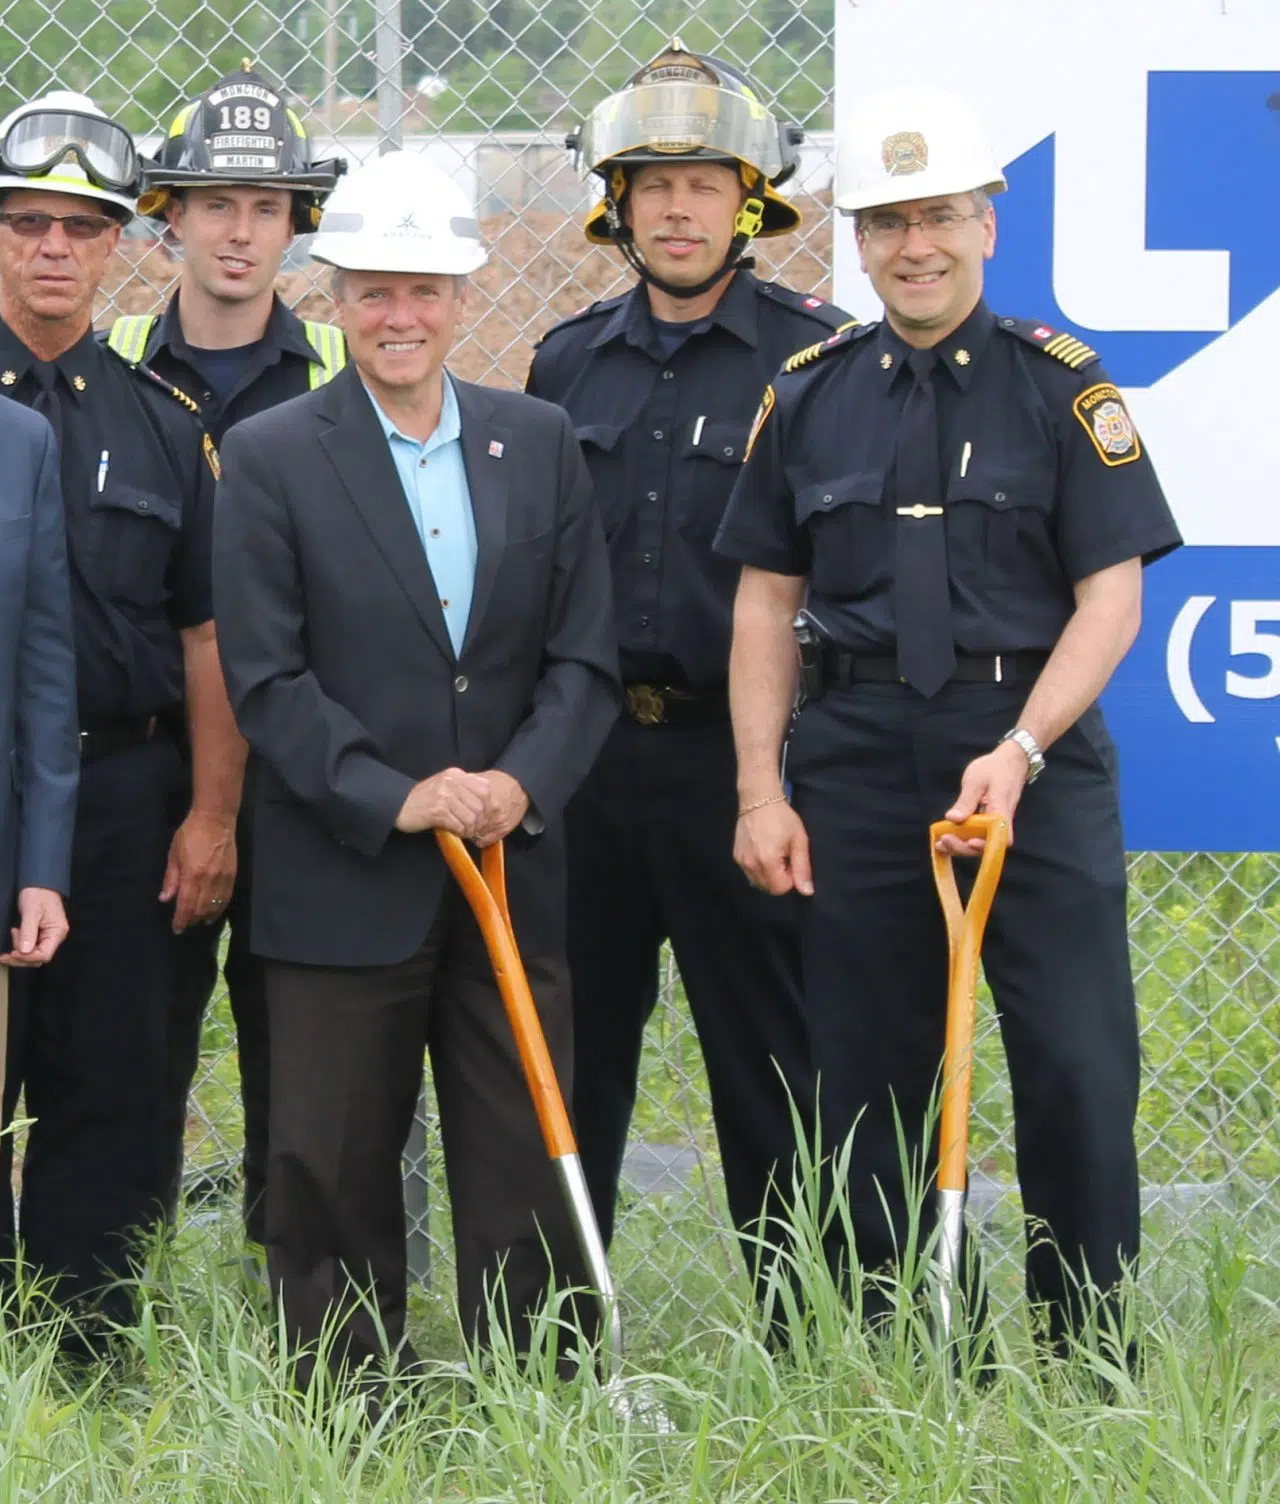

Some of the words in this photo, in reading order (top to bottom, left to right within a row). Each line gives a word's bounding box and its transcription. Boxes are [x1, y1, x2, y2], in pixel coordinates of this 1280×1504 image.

[220, 83, 271, 98] MONCTON
[220, 105, 271, 131] 189
[215, 136, 274, 149] FIREFIGHTER
[226, 155, 264, 167] MARTIN
[1166, 596, 1280, 724] (5
